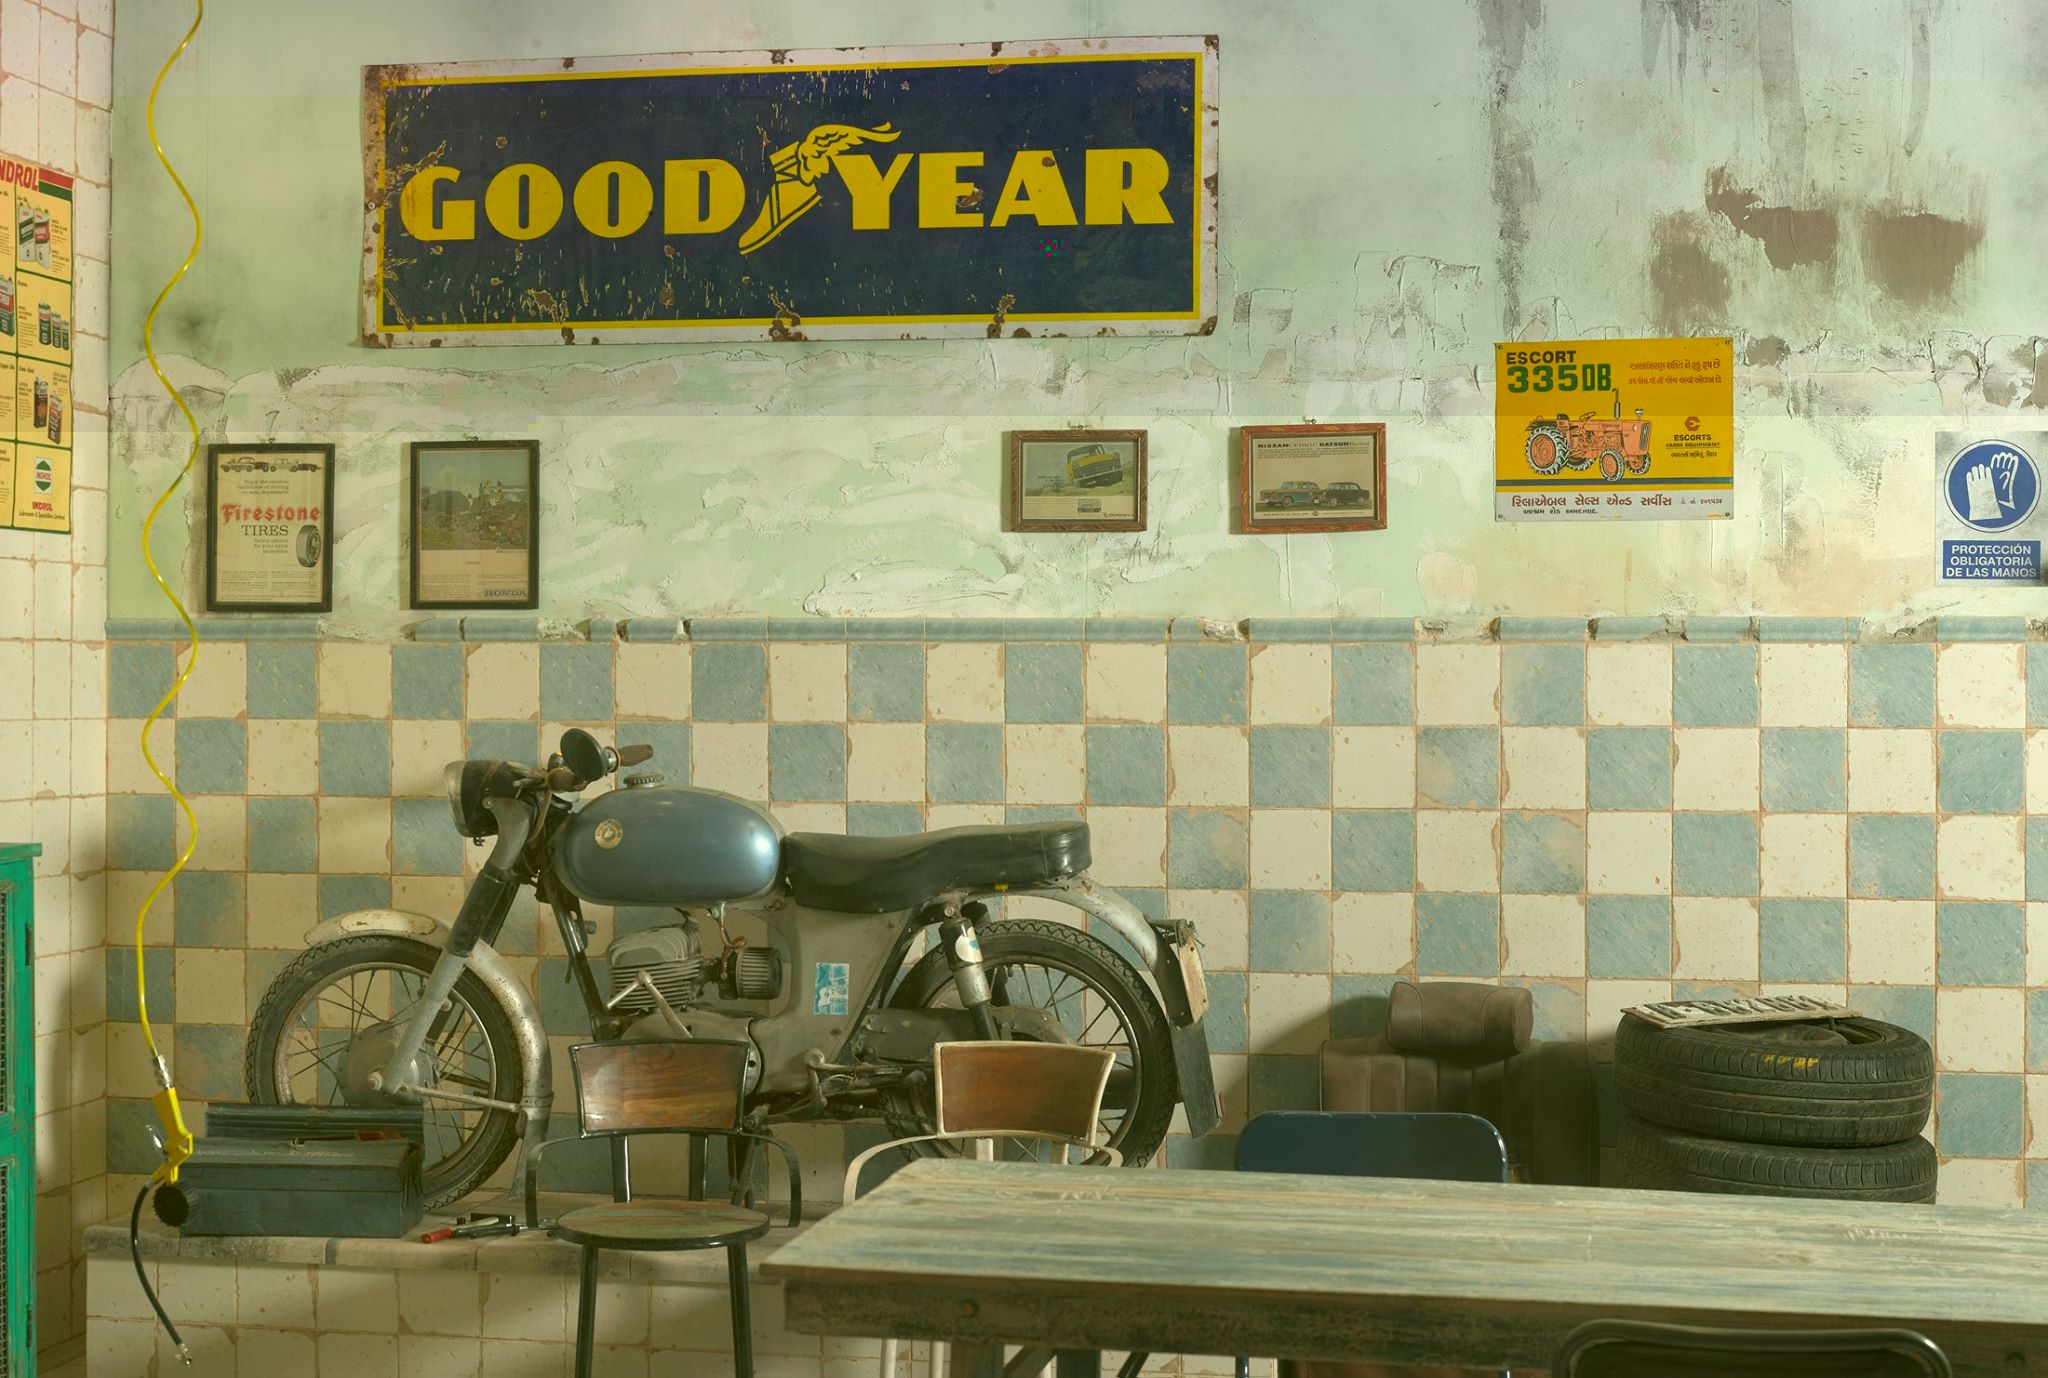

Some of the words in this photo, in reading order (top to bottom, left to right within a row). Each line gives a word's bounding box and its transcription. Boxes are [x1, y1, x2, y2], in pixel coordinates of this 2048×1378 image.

[1506, 350, 1577, 364] ESCORT
[36, 471, 52, 481] INDROL
[32, 501, 53, 511] INDROL
[221, 503, 321, 525] Firestone
[241, 525, 289, 536] TIRES
[1951, 543, 2032, 554] PROTECCIÓN
[1950, 556, 2032, 566] OBLIGATORIA
[1946, 567, 1962, 577] DE
[1966, 567, 1988, 577] LAS
[1992, 567, 2036, 578] MANOS
